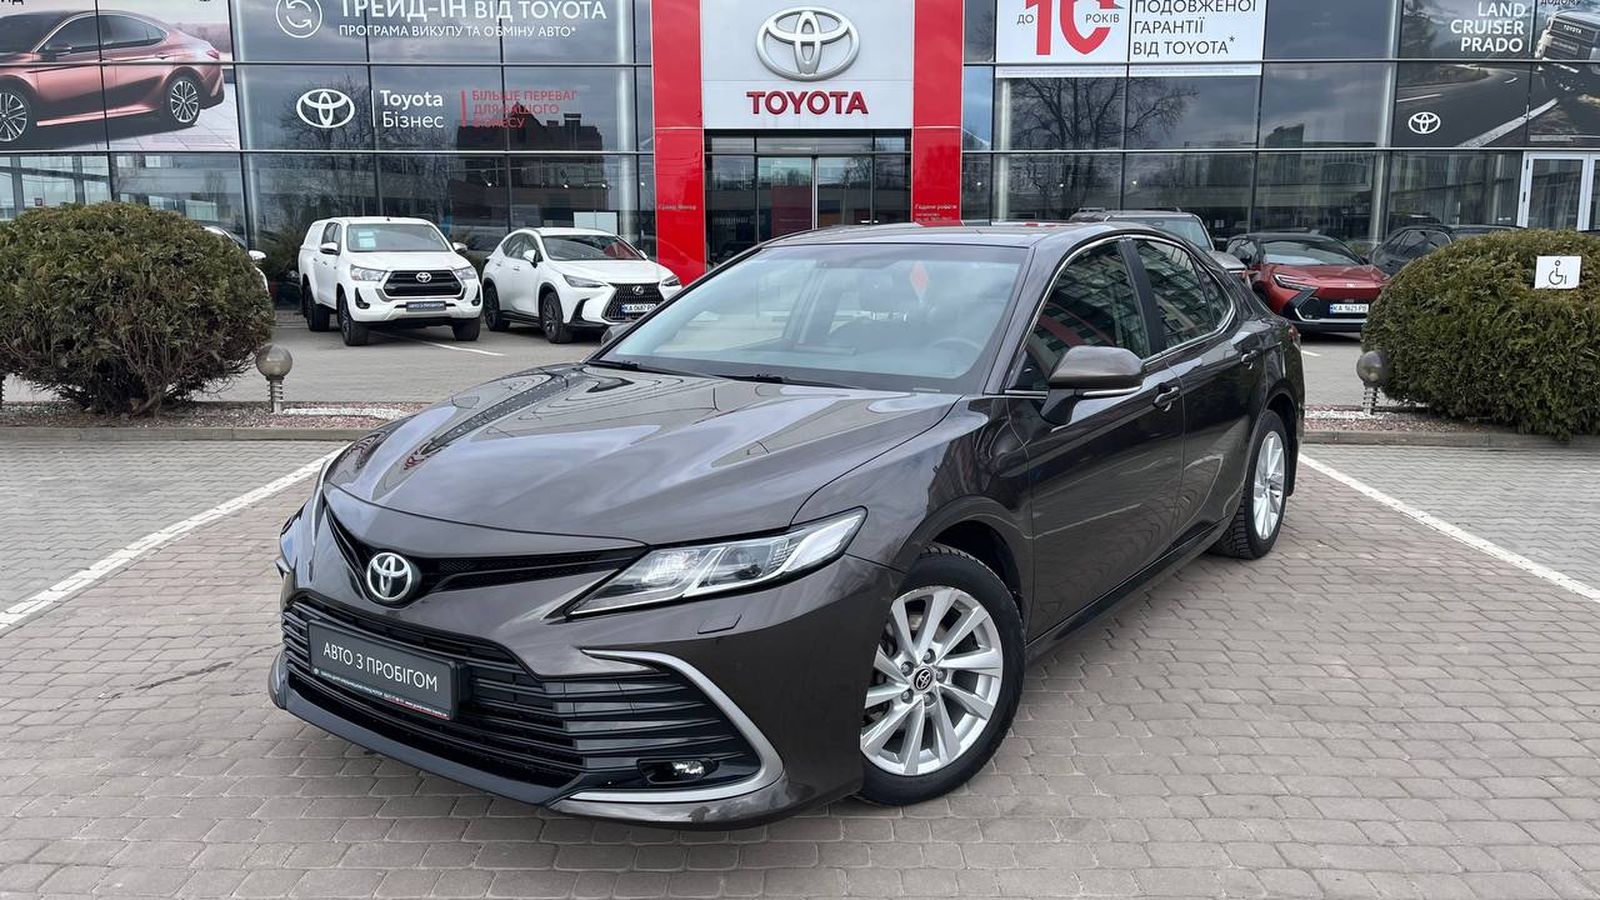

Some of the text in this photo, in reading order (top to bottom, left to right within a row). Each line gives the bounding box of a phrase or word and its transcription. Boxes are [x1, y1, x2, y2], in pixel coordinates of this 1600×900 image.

[474, 1, 513, 23] ВІД
[518, 1, 607, 19] TOYOTA
[1477, 2, 1525, 18] LAND
[1016, 14, 1035, 25] ДО
[1085, 13, 1120, 23] РОКІВ
[1134, 16, 1205, 34] ГАРАНТІЇ
[1450, 19, 1524, 35] CRUISER
[339, 24, 409, 37] ПРОГРАМА
[412, 25, 463, 37] ВИКУПУ
[466, 25, 481, 37] ТА
[484, 25, 535, 37] ОБМІНУ
[1133, 41, 1160, 58] ВІД
[1460, 37, 1524, 53] PRADO
[380, 89, 443, 110] Toyota
[524, 89, 577, 101] ПЕРЕВАГ
[746, 90, 869, 115] TOYOTA
[382, 110, 444, 128] Бізнес
[323, 641, 353, 665] АВТО
[356, 653, 364, 669] З
[366, 656, 438, 693] ПРОБІГОМ
